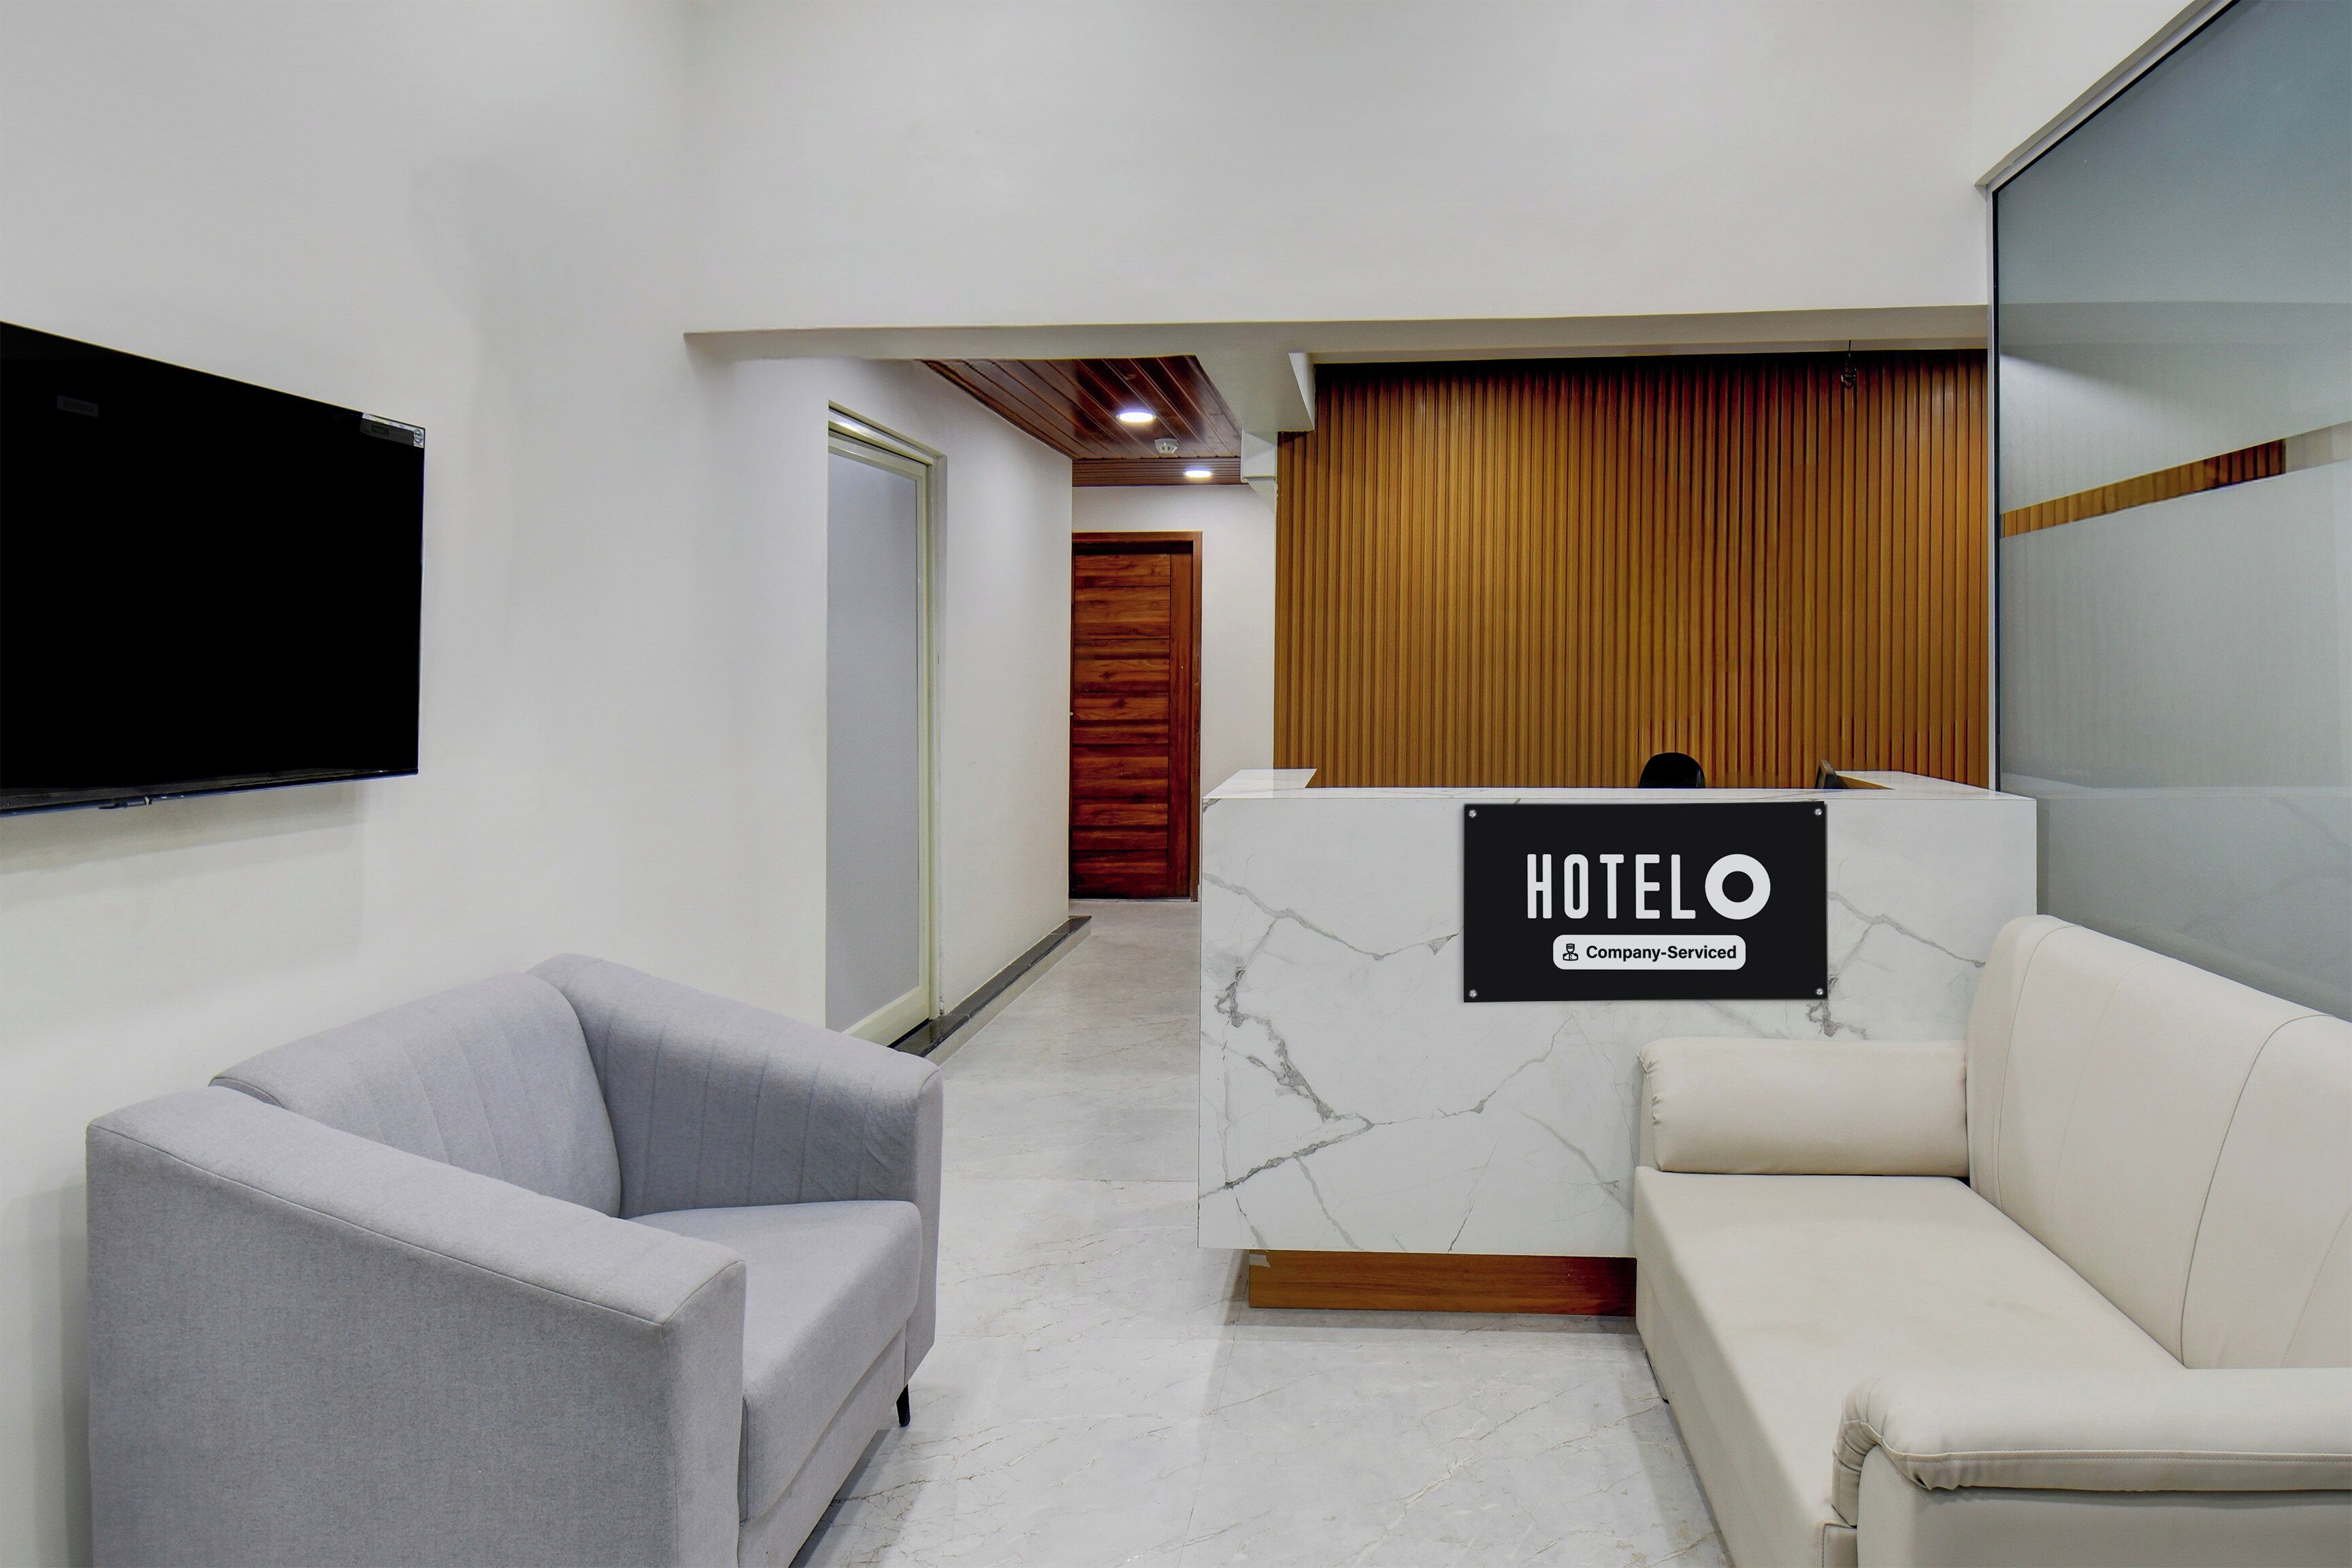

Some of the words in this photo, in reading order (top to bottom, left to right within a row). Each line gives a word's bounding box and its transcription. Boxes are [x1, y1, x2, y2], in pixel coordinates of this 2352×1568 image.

[1527, 853, 1696, 919] HOTEL
[1705, 853, 1771, 920] O
[1586, 945, 1737, 962] Company-Serviced
